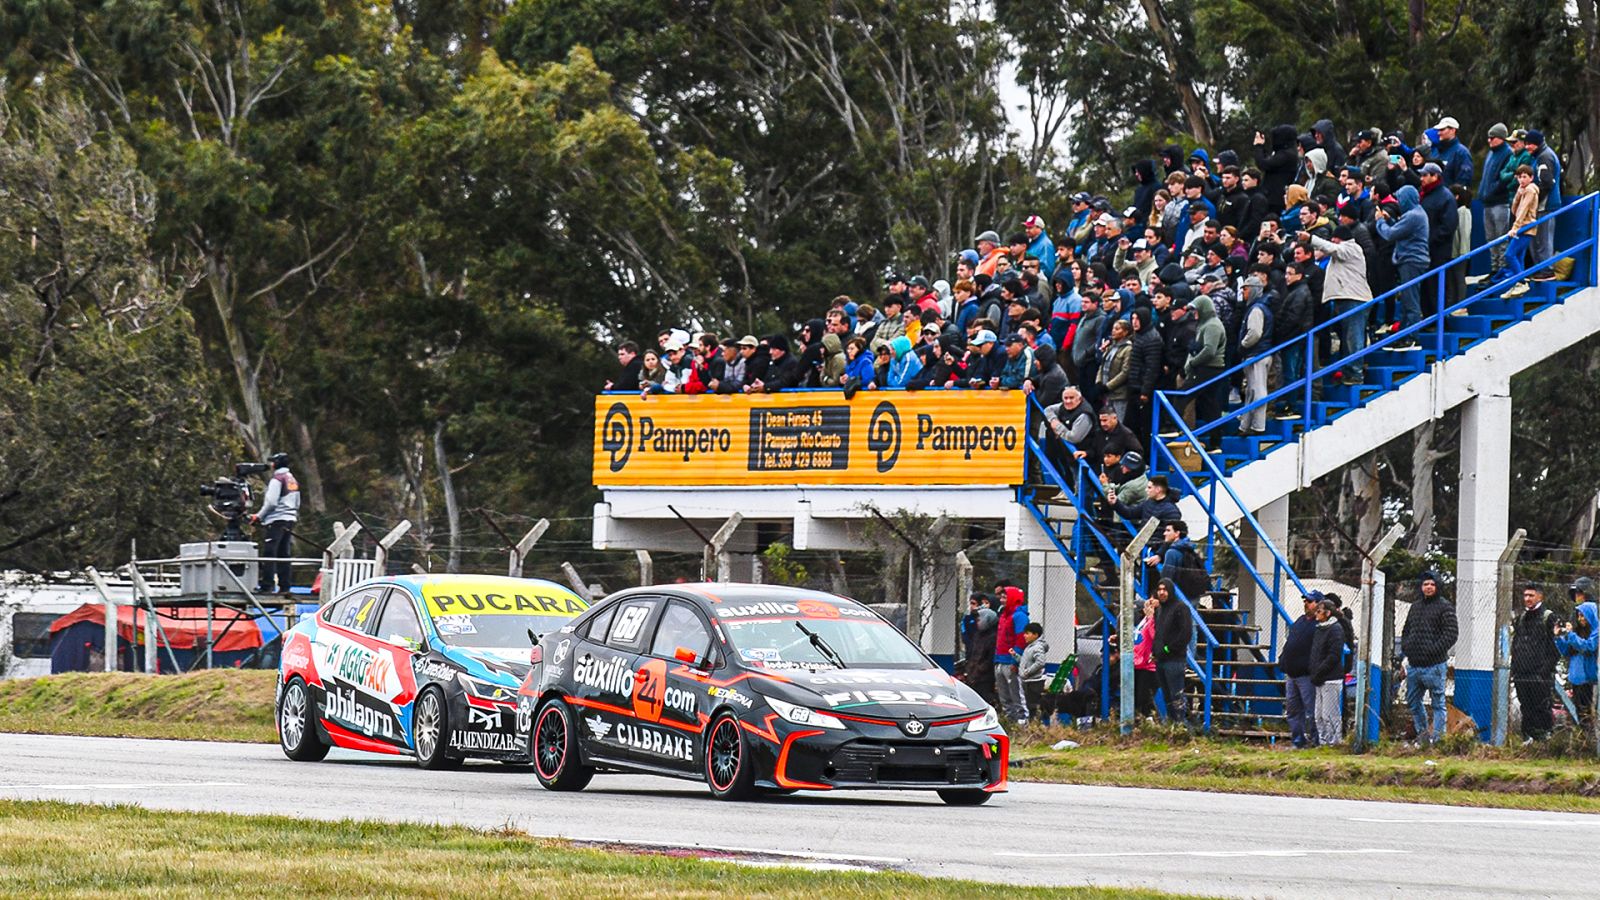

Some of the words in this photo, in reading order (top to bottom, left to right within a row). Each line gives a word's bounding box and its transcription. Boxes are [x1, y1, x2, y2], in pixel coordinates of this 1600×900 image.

[788, 411, 810, 427] Funes
[916, 413, 1017, 460] Pampero
[638, 416, 731, 462] Pampero
[765, 432, 798, 452] Pampero
[815, 431, 841, 448] Cuarto
[432, 593, 585, 613] PUCARA
[612, 606, 650, 641] 68
[324, 686, 393, 738] philagro
[790, 707, 810, 722] 68
[616, 722, 694, 761] CILBRAKE
